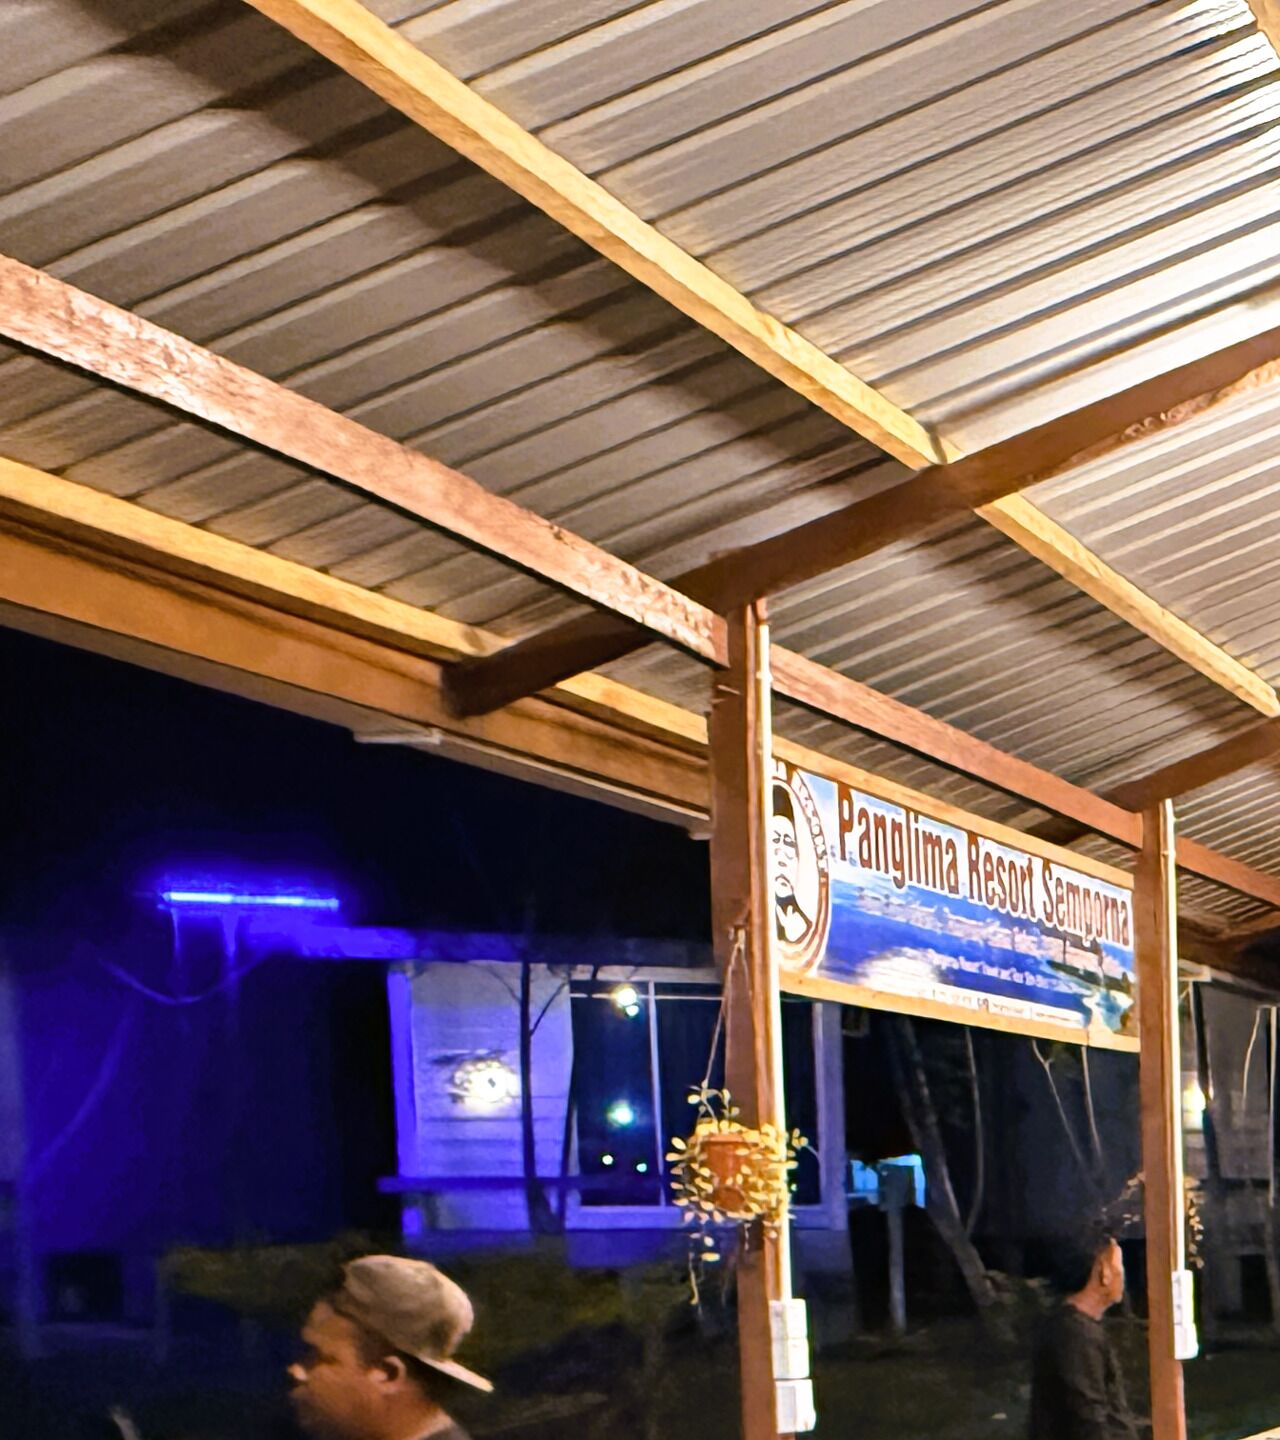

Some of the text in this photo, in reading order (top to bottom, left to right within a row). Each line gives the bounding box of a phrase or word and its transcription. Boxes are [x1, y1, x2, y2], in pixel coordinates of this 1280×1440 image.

[838, 787, 960, 894] Panglima
[968, 832, 1037, 919] Resort
[1042, 858, 1130, 948] Semporna
